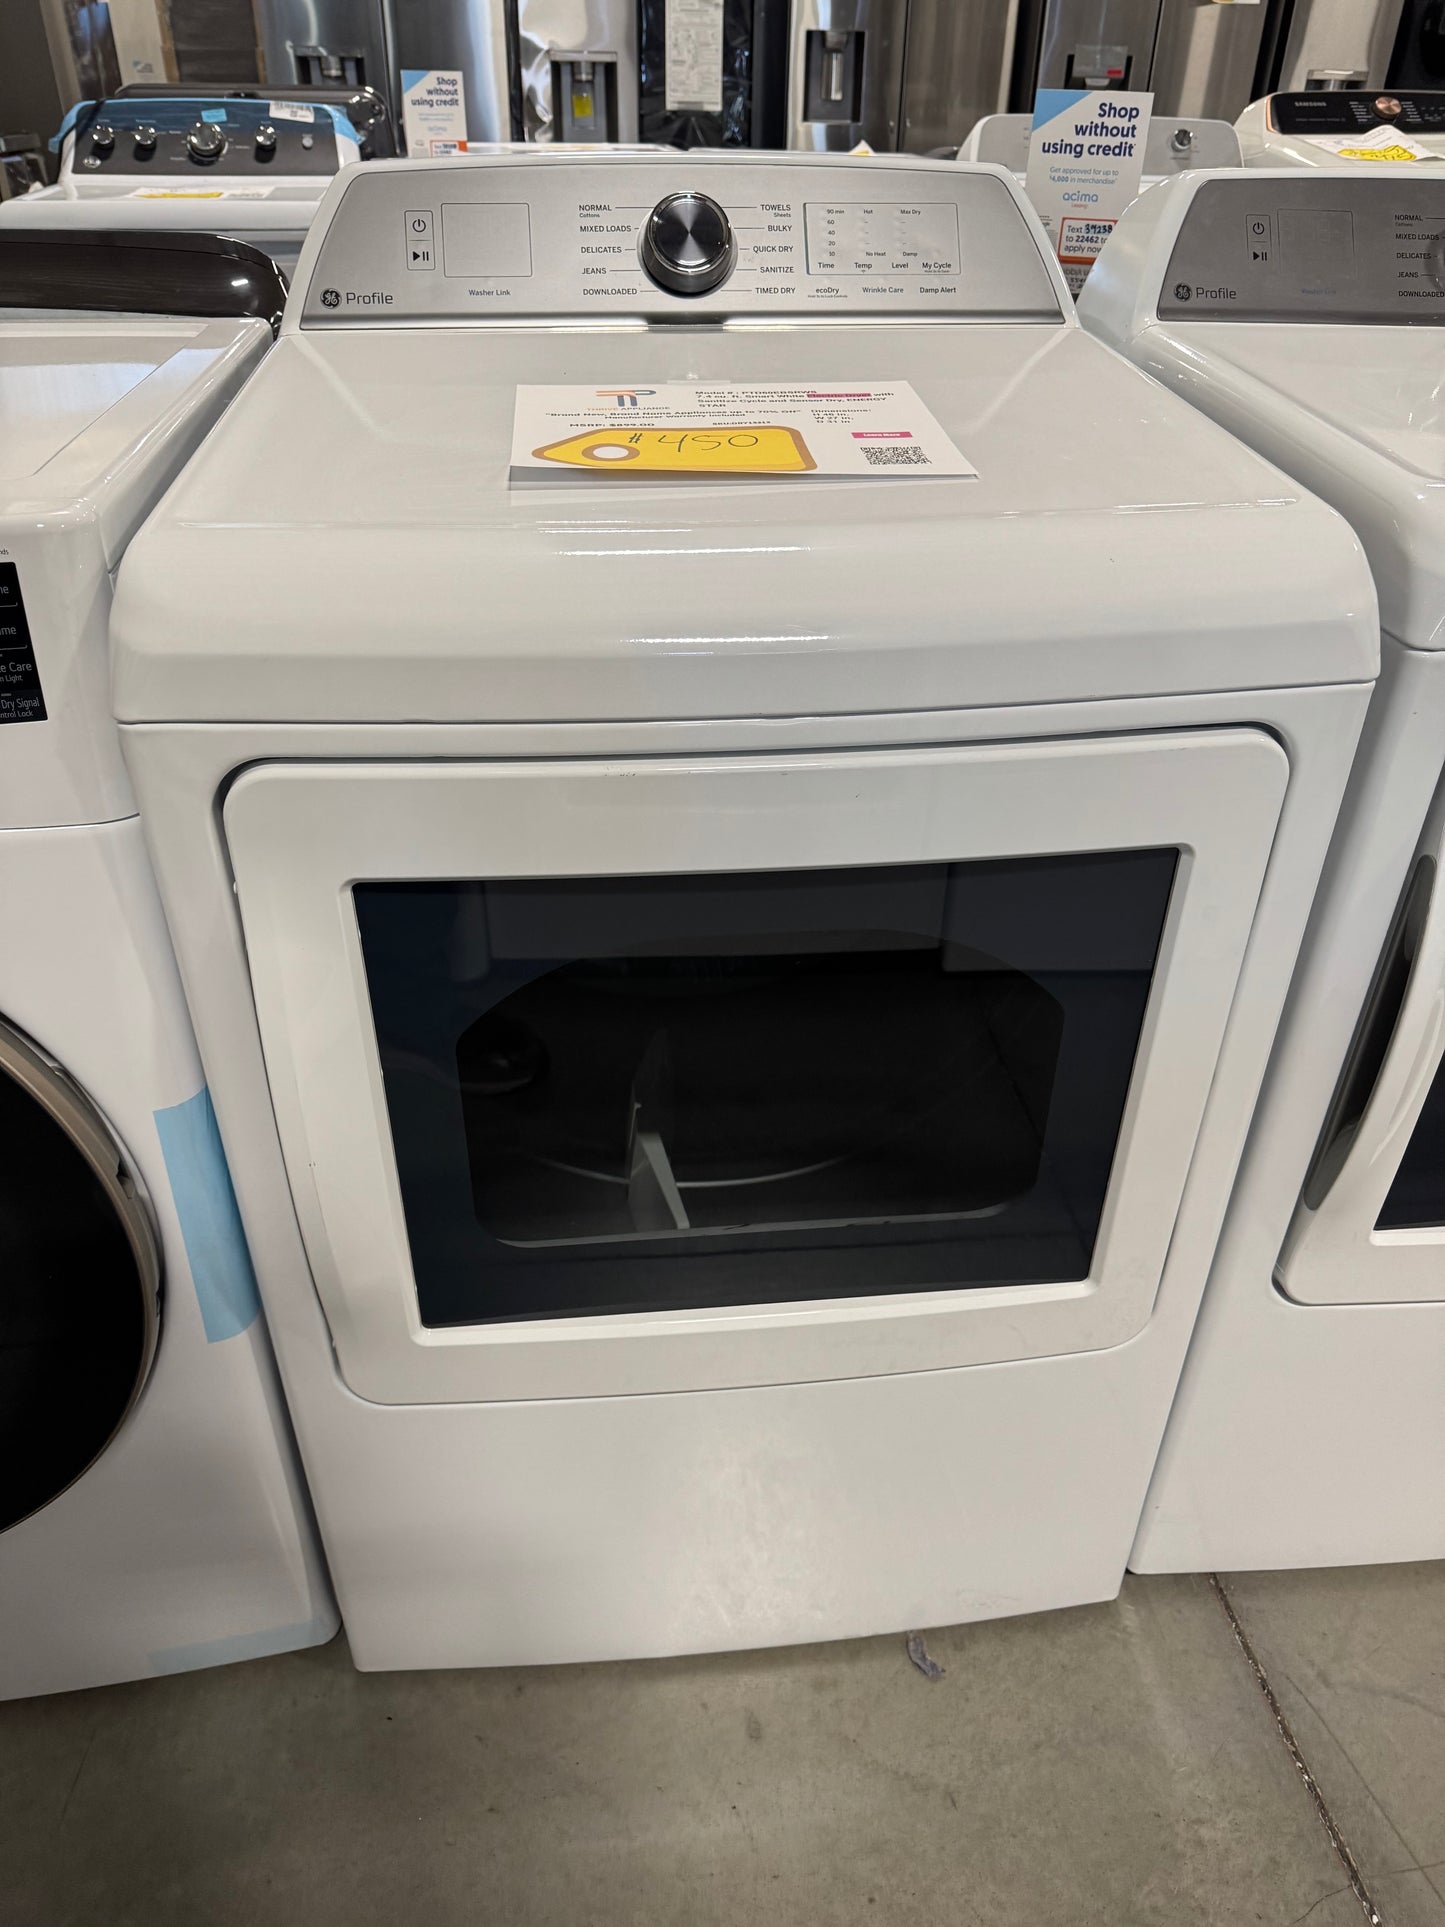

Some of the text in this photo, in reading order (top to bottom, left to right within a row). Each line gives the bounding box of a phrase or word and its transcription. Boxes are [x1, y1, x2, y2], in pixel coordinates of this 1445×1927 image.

[436, 76, 457, 86] Shop
[426, 88, 458, 96] without
[411, 97, 459, 108] using credit
[1098, 102, 1139, 122] Shop
[1075, 121, 1136, 138] without
[1042, 139, 1084, 158] using
[1062, 167, 1092, 175] approved
[1062, 190, 1099, 202] acima
[579, 204, 612, 212] NORMAL
[580, 225, 631, 233] MIXED LOADS
[1067, 225, 1083, 234] Text
[1075, 235, 1099, 244] 22462
[581, 246, 622, 254] DELICATES
[1064, 244, 1086, 254] apply
[582, 267, 607, 275] JEANS
[468, 289, 494, 297] Washer
[583, 288, 637, 296] DOWNLOADED
[1196, 287, 1237, 299] Profile
[1398, 290, 1445, 298] DOWNLOADED
[346, 292, 394, 305] Profile
[628, 433, 759, 452] # 450
[9, 662, 32, 673] Care
[5, 675, 23, 683] Light
[1, 697, 40, 711] Dry Signal
